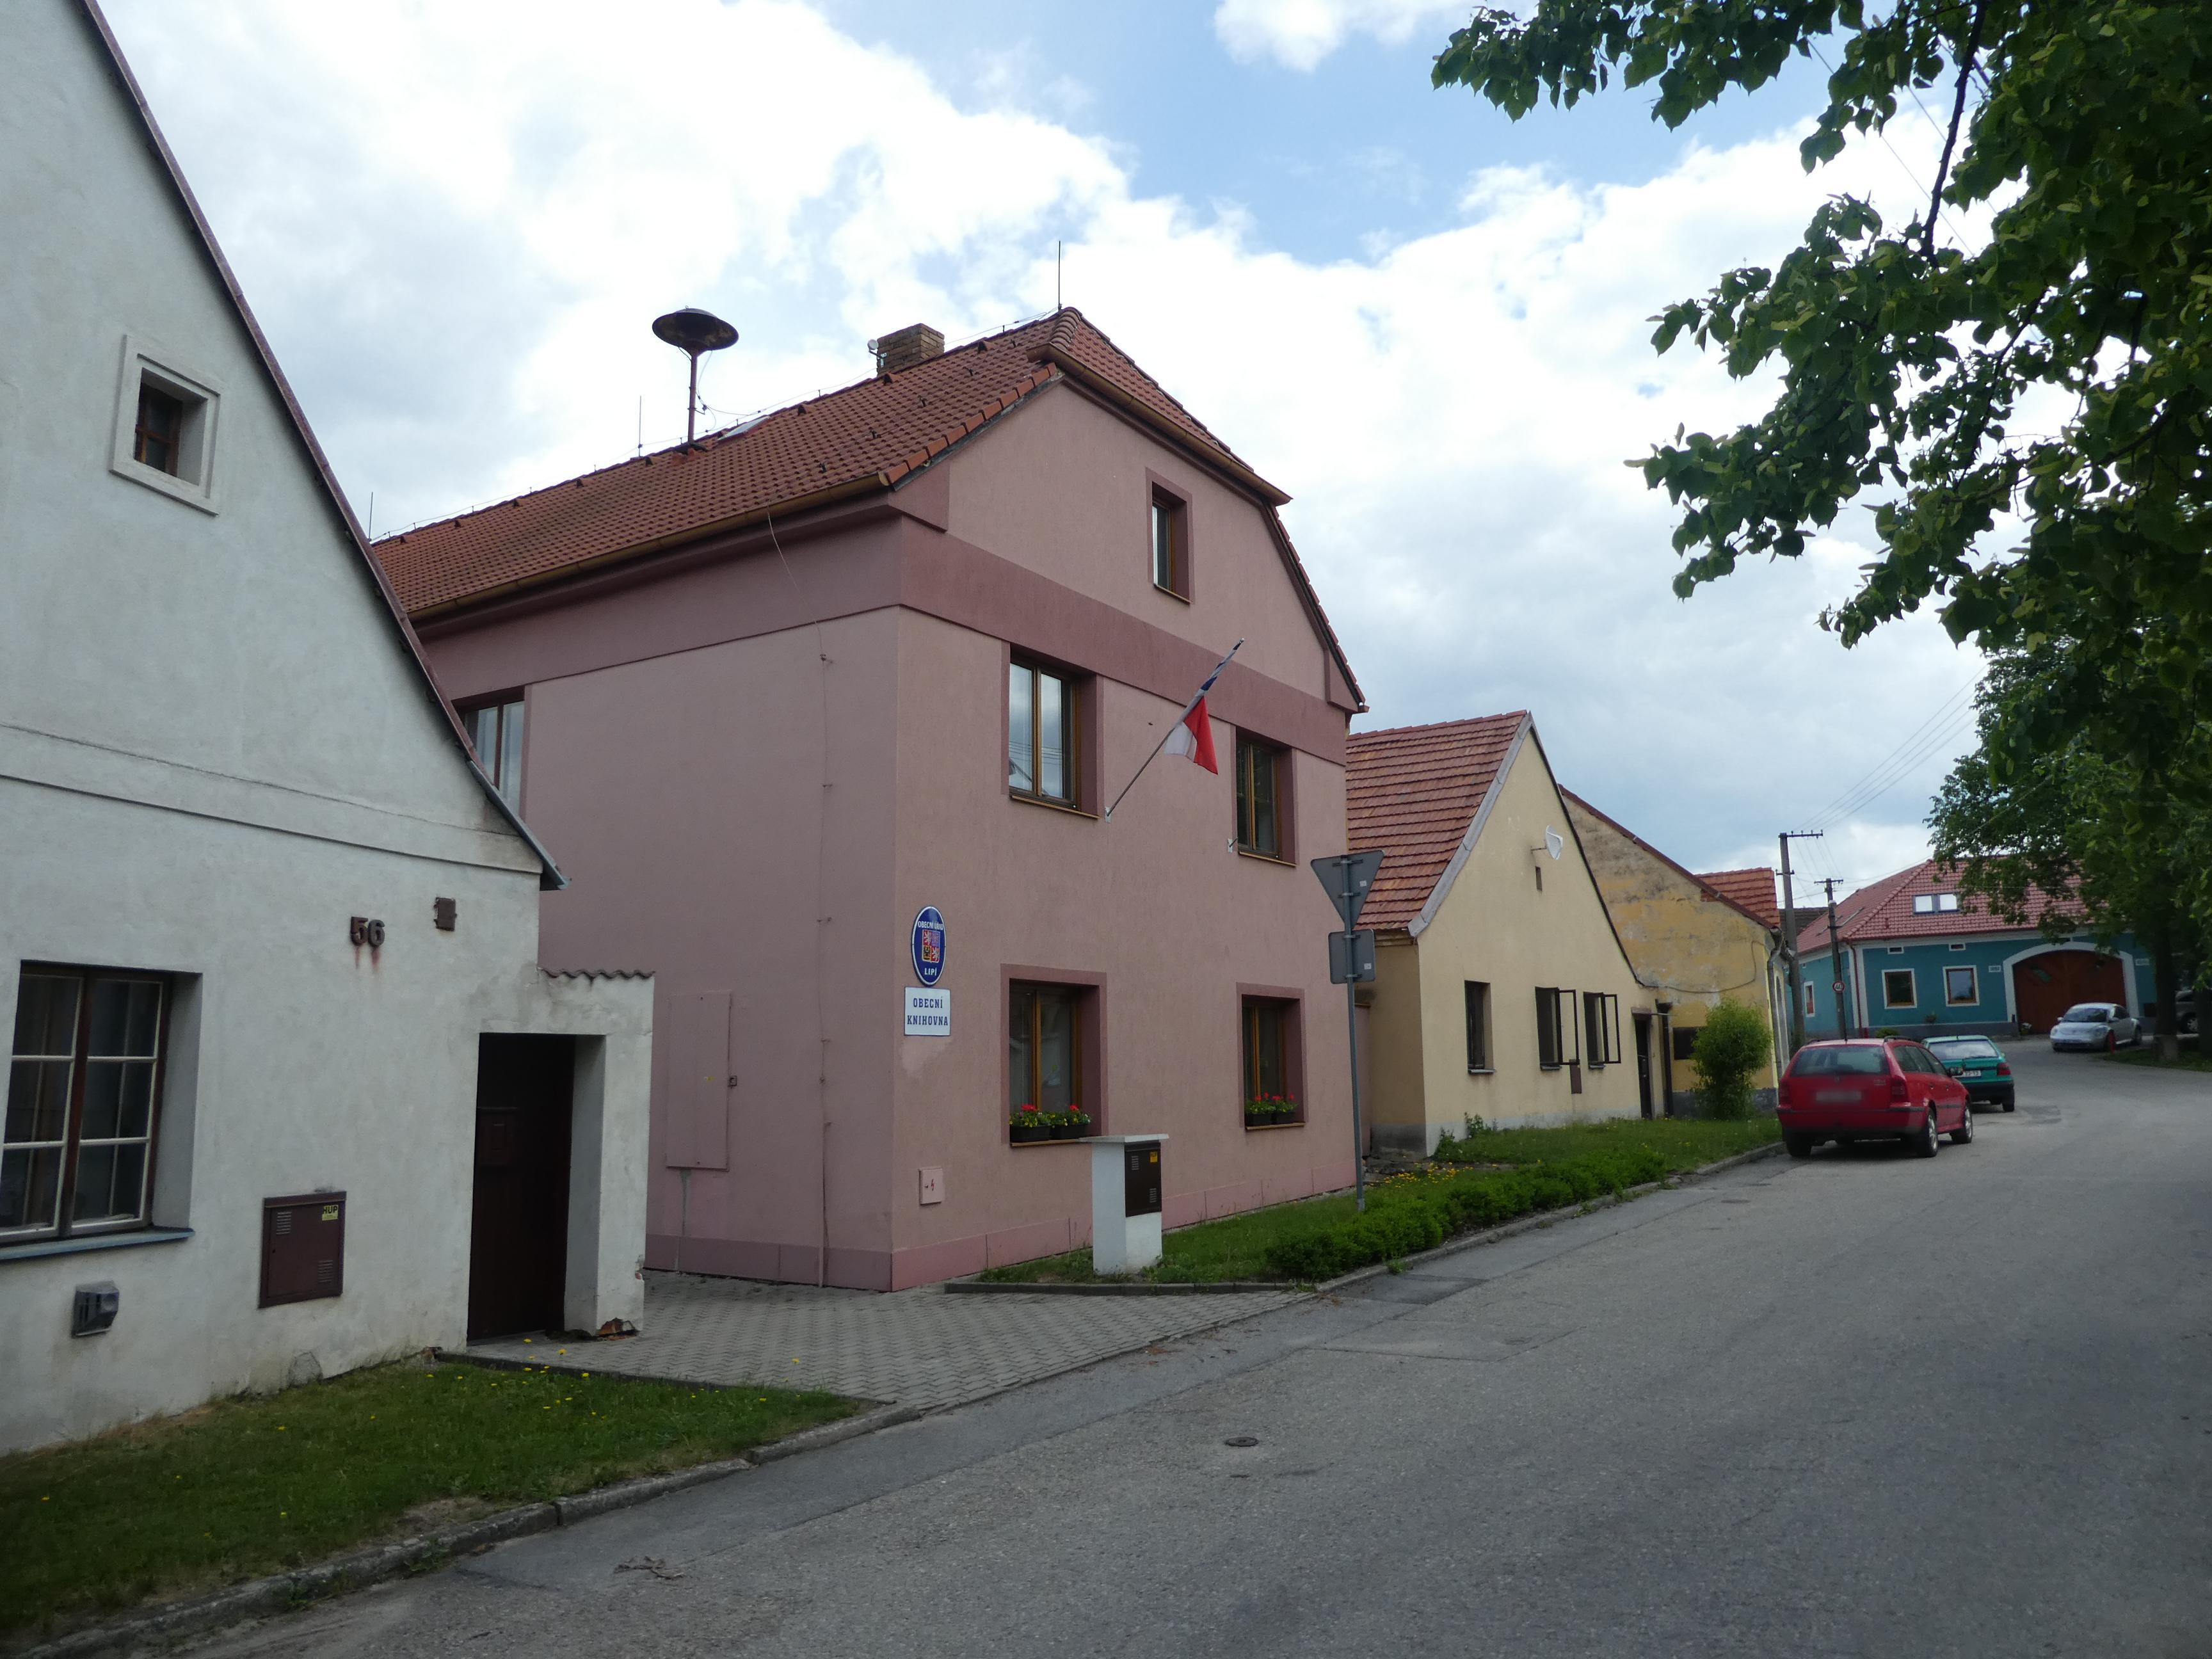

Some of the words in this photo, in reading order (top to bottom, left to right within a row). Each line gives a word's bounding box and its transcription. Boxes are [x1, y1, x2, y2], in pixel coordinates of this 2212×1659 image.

[350, 916, 385, 947] 56
[924, 967, 937, 976] LIPÍ
[913, 996, 943, 1009] OBECNÍ
[906, 1014, 949, 1026] KNIHOVNA
[323, 1205, 338, 1214] HUP
